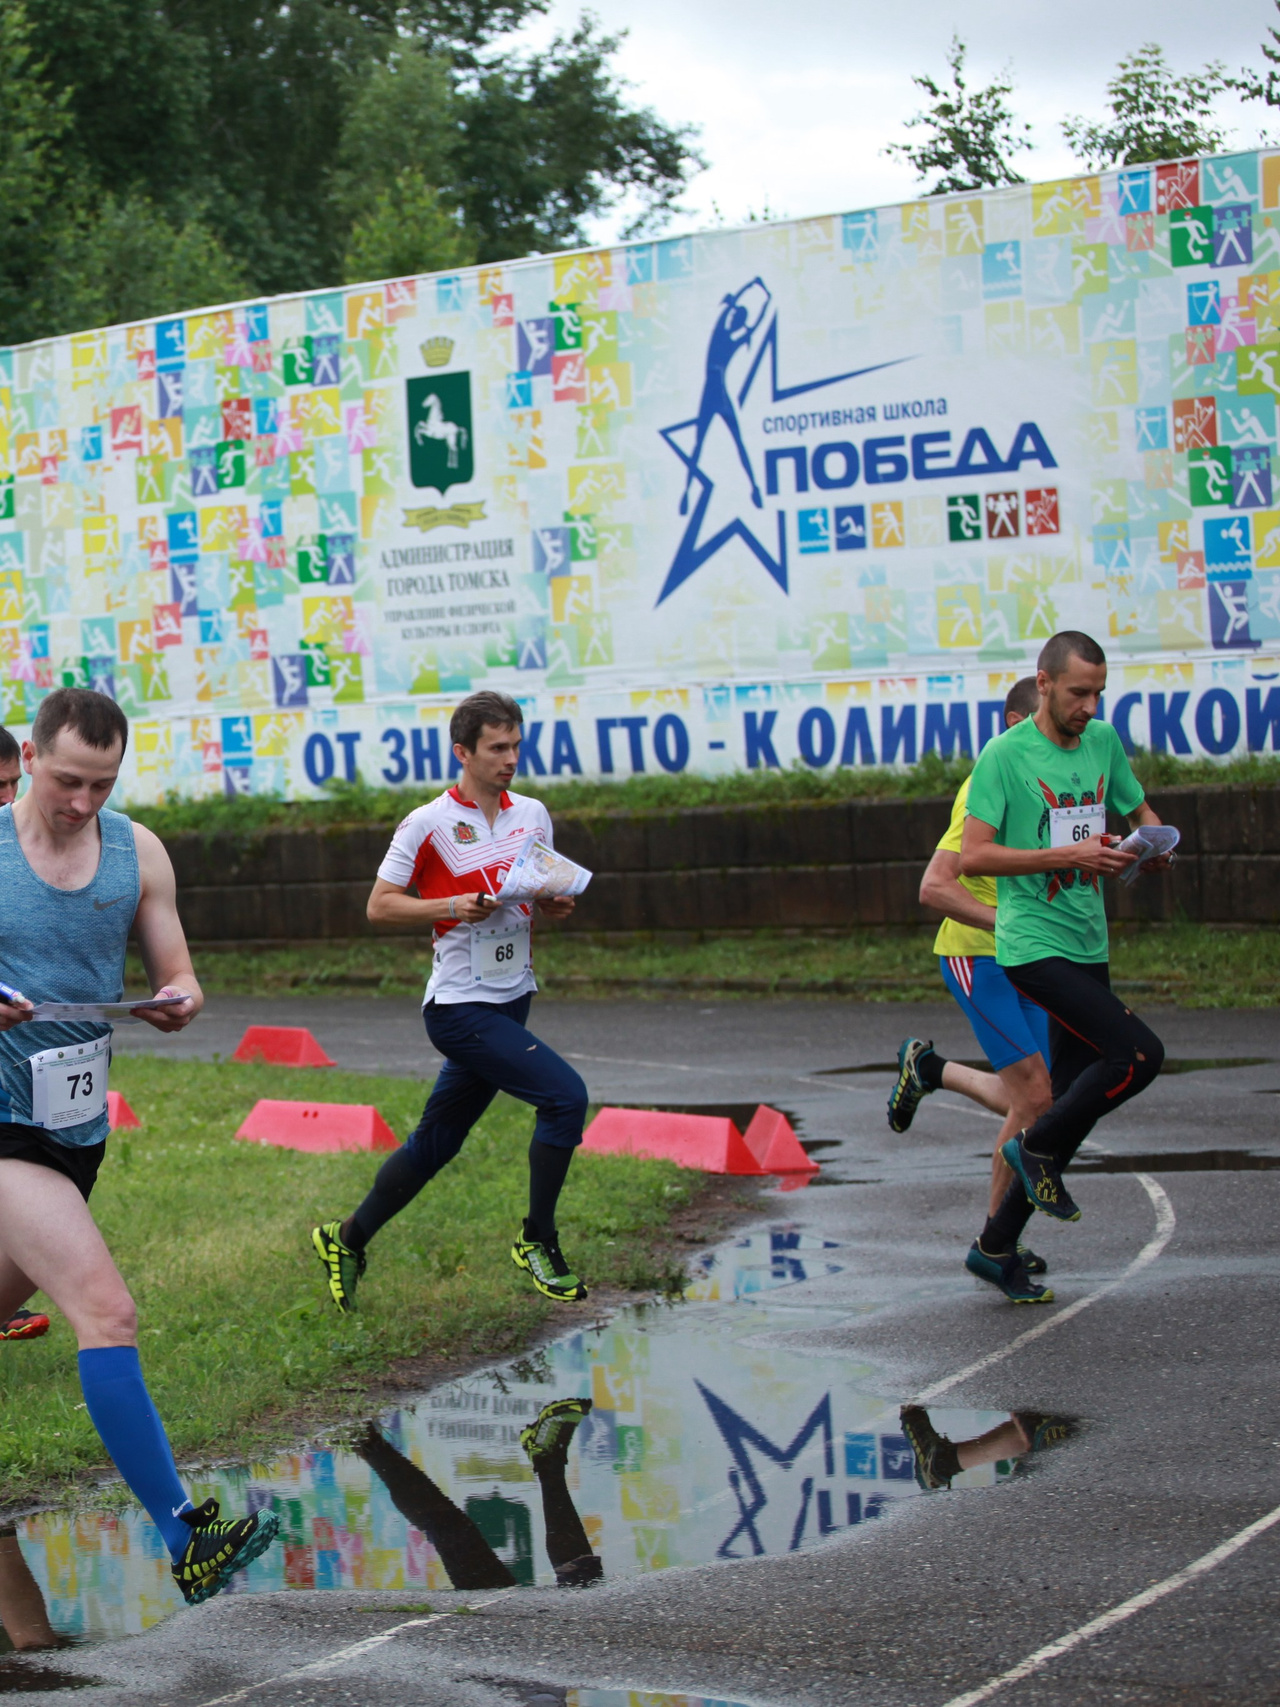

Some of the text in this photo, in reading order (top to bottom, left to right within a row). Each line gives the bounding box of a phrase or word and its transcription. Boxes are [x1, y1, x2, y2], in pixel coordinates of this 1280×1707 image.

[762, 397, 948, 436] спортивная школа
[764, 421, 1059, 496] ПОБЕДА
[381, 538, 515, 569] АДМИНИСТРАЦИЯ
[387, 569, 510, 597] ГОРОДА ТОМСКА
[304, 731, 361, 787] ОТ
[596, 713, 690, 774] ГТО
[743, 709, 781, 769] К
[1072, 823, 1090, 842] 66
[495, 943, 514, 962] 68
[66, 1071, 94, 1100] 73
